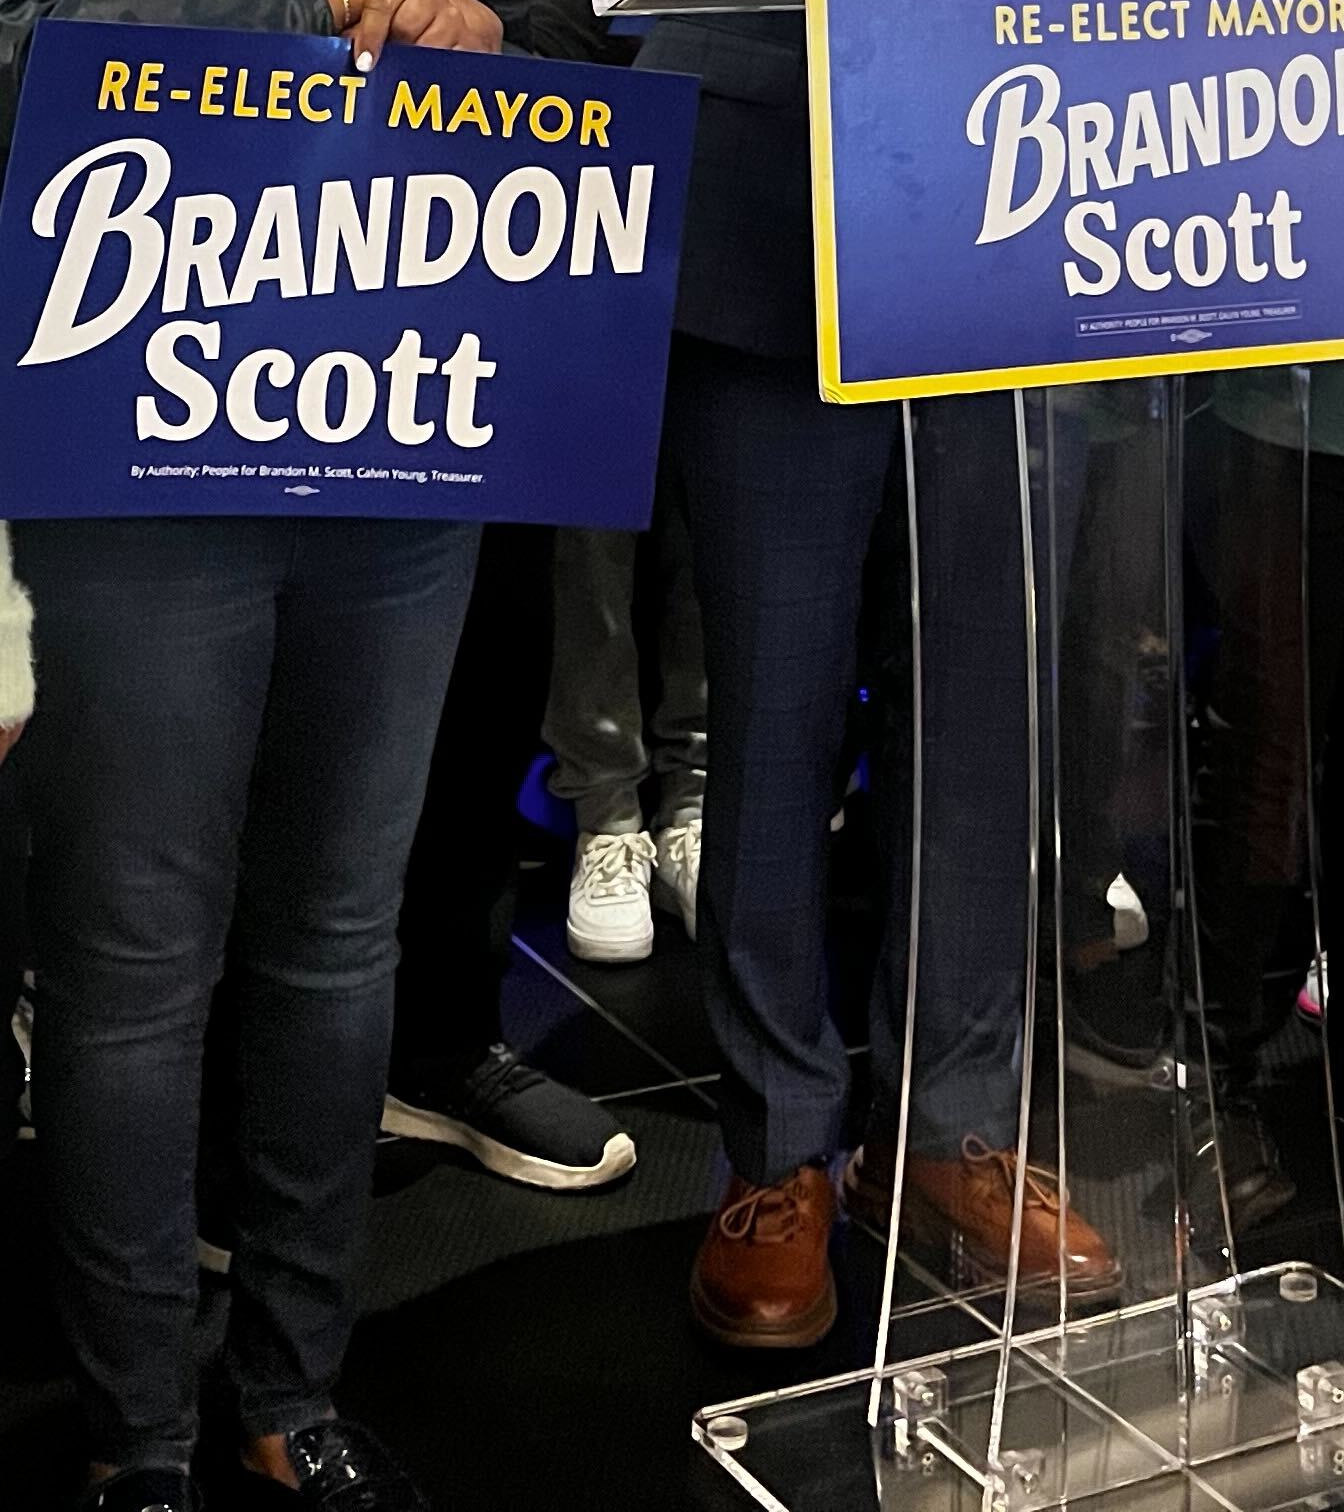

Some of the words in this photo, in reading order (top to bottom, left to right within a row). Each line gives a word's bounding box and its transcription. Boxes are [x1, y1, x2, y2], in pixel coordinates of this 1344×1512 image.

[995, 0, 1190, 45] RE-ELECT
[97, 60, 366, 125] RE-ELECT
[388, 80, 612, 148] MAYOR
[16, 138, 654, 367] BRANDON
[1062, 190, 1307, 297] Scott
[136, 321, 497, 448] Scott
[131, 465, 146, 479] By
[202, 465, 239, 478] People
[241, 464, 257, 477] for
[259, 465, 306, 478] Brandon
[356, 467, 390, 479] Calvin
